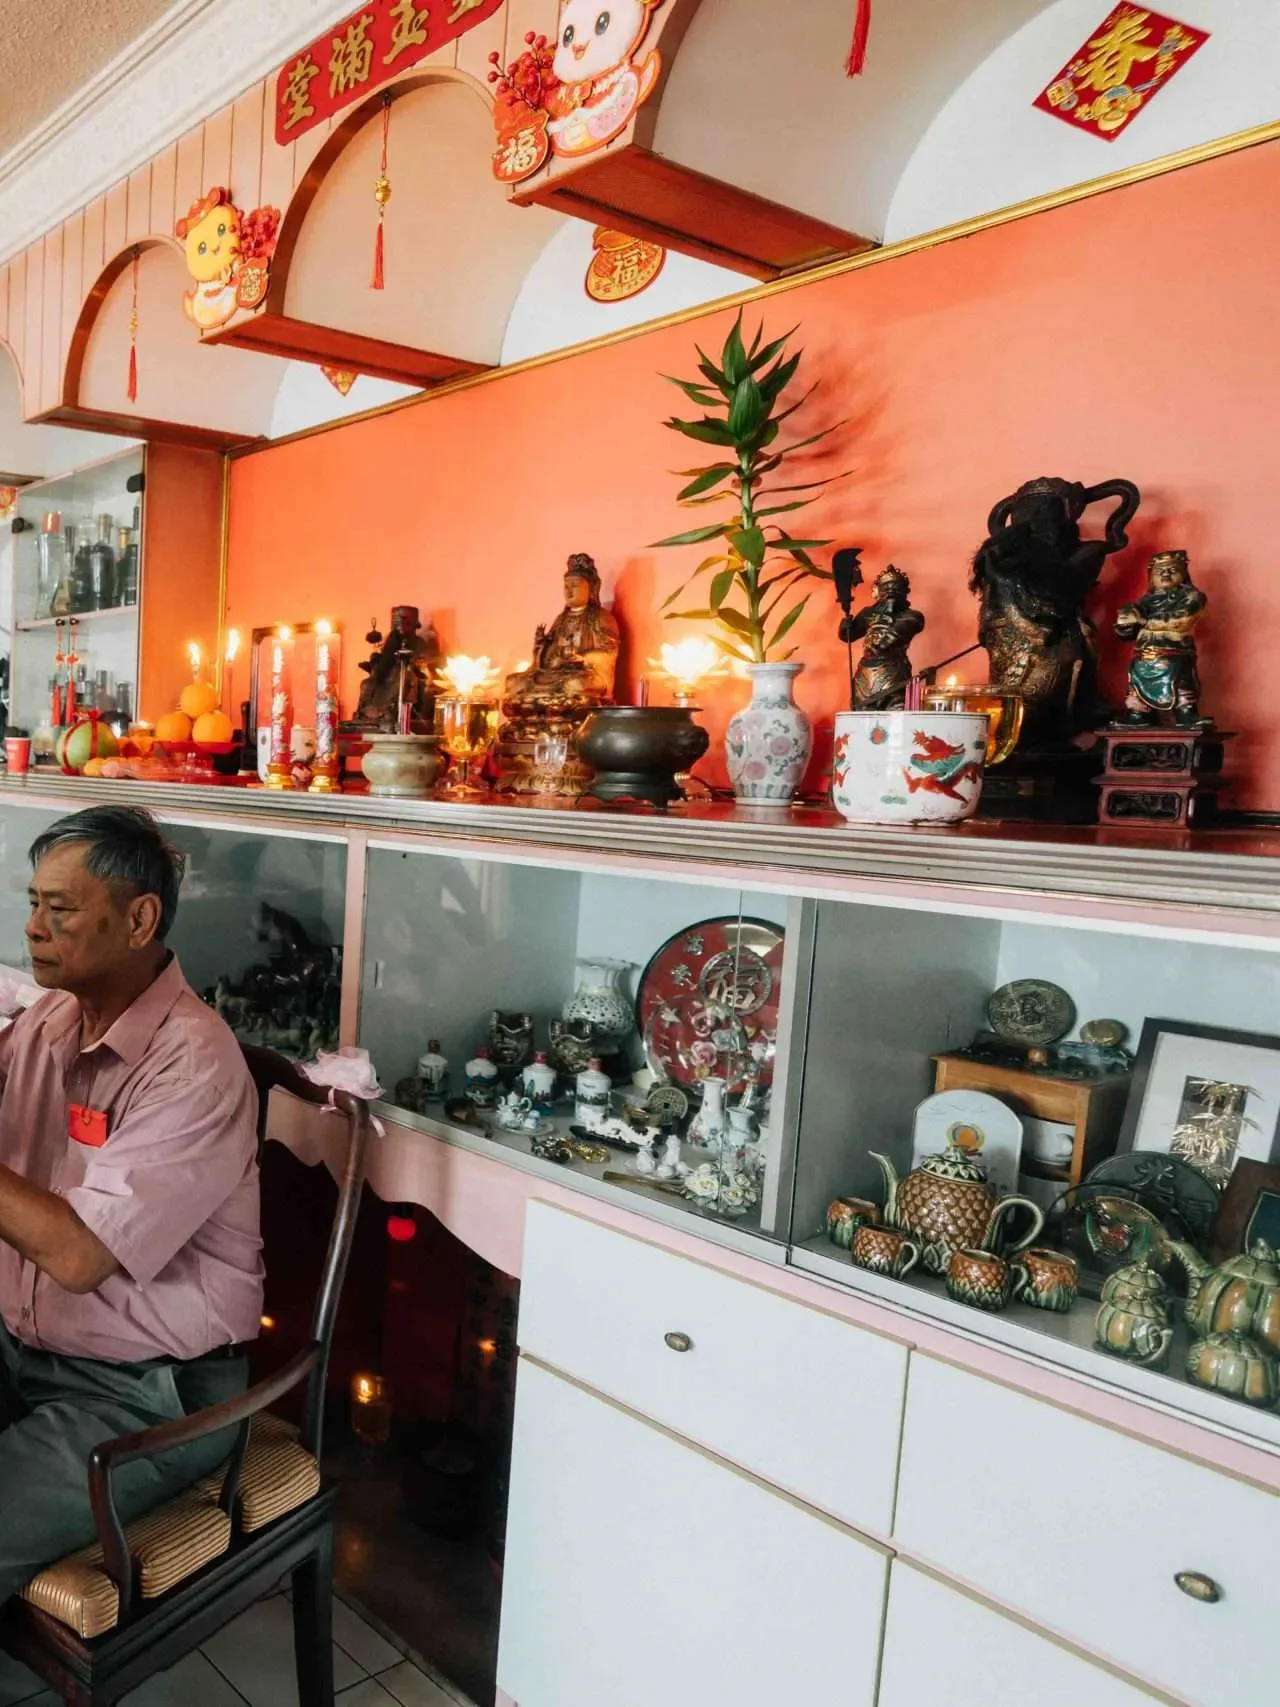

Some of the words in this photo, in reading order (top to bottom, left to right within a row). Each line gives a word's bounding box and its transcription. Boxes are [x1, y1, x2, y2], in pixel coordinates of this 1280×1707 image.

[1075, 12, 1160, 92] 春
[500, 127, 538, 177] 福
[613, 248, 642, 285] 福
